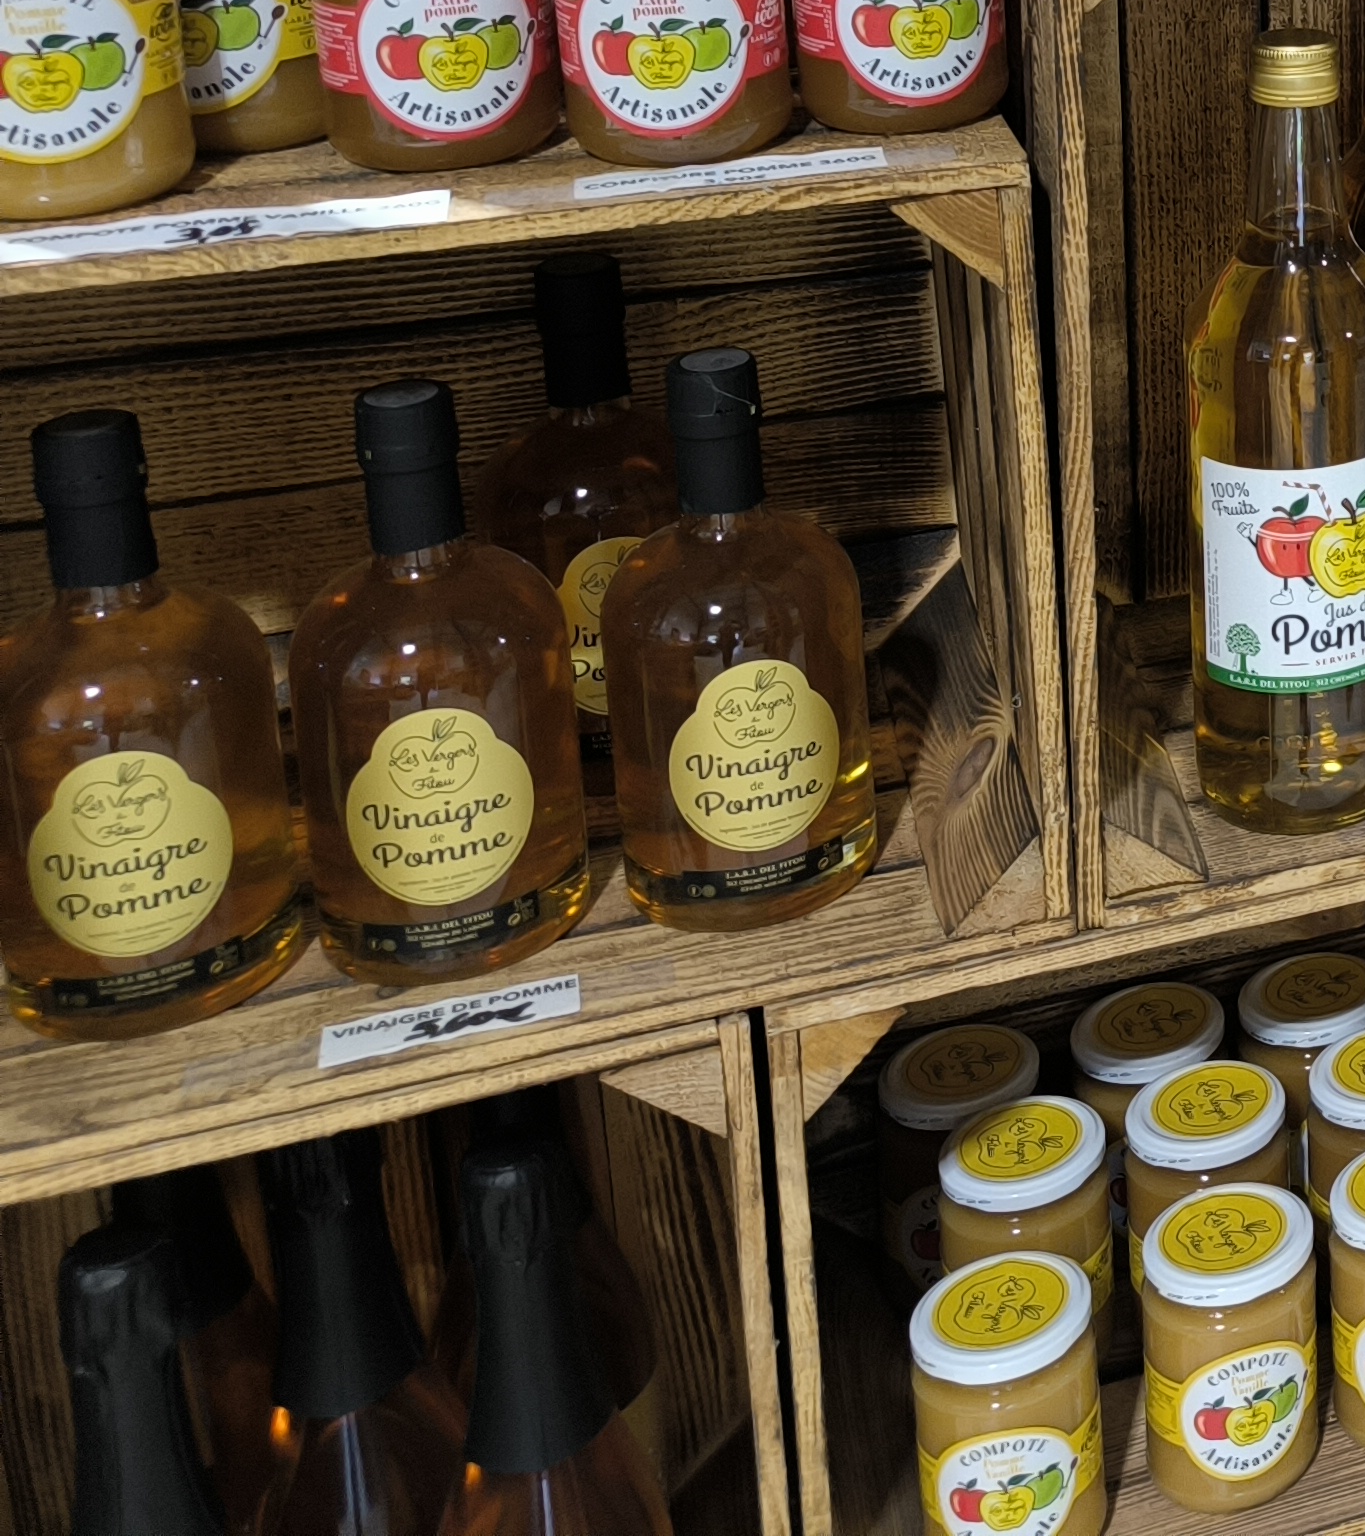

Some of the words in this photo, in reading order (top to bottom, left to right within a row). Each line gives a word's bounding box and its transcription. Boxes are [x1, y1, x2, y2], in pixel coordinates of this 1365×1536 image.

[423, 3, 478, 17] pomme
[632, 4, 685, 16] pomme
[860, 47, 978, 92] Artisanale
[389, 78, 520, 126] Artisanale
[601, 80, 728, 124] Artisanale
[1211, 481, 1249, 498] 100%
[1212, 500, 1260, 516] Fruits
[1324, 603, 1357, 627] Jus
[1315, 652, 1357, 666] SERVIR
[714, 700, 741, 722] Les
[746, 694, 794, 718] Vergers
[735, 725, 775, 741] Fitou
[389, 747, 419, 772] Les
[421, 745, 476, 770] Vergers
[686, 740, 822, 780] Vinaigre
[412, 778, 455, 791] Fitou
[695, 778, 823, 816] Pomme
[750, 780, 764, 791] de
[362, 792, 511, 832] Vinaigre
[373, 831, 513, 868] Pomme
[430, 832, 445, 844] de
[44, 837, 208, 881] Vinaigre
[57, 877, 211, 920] Pomme
[332, 1008, 445, 1039] VINAIGRE
[452, 999, 482, 1013] DE
[489, 979, 577, 1005] POMME
[1207, 1352, 1289, 1387] COMPOTE
[959, 1437, 1049, 1468] COMPOTE
[1200, 1422, 1295, 1472] Artisanale
